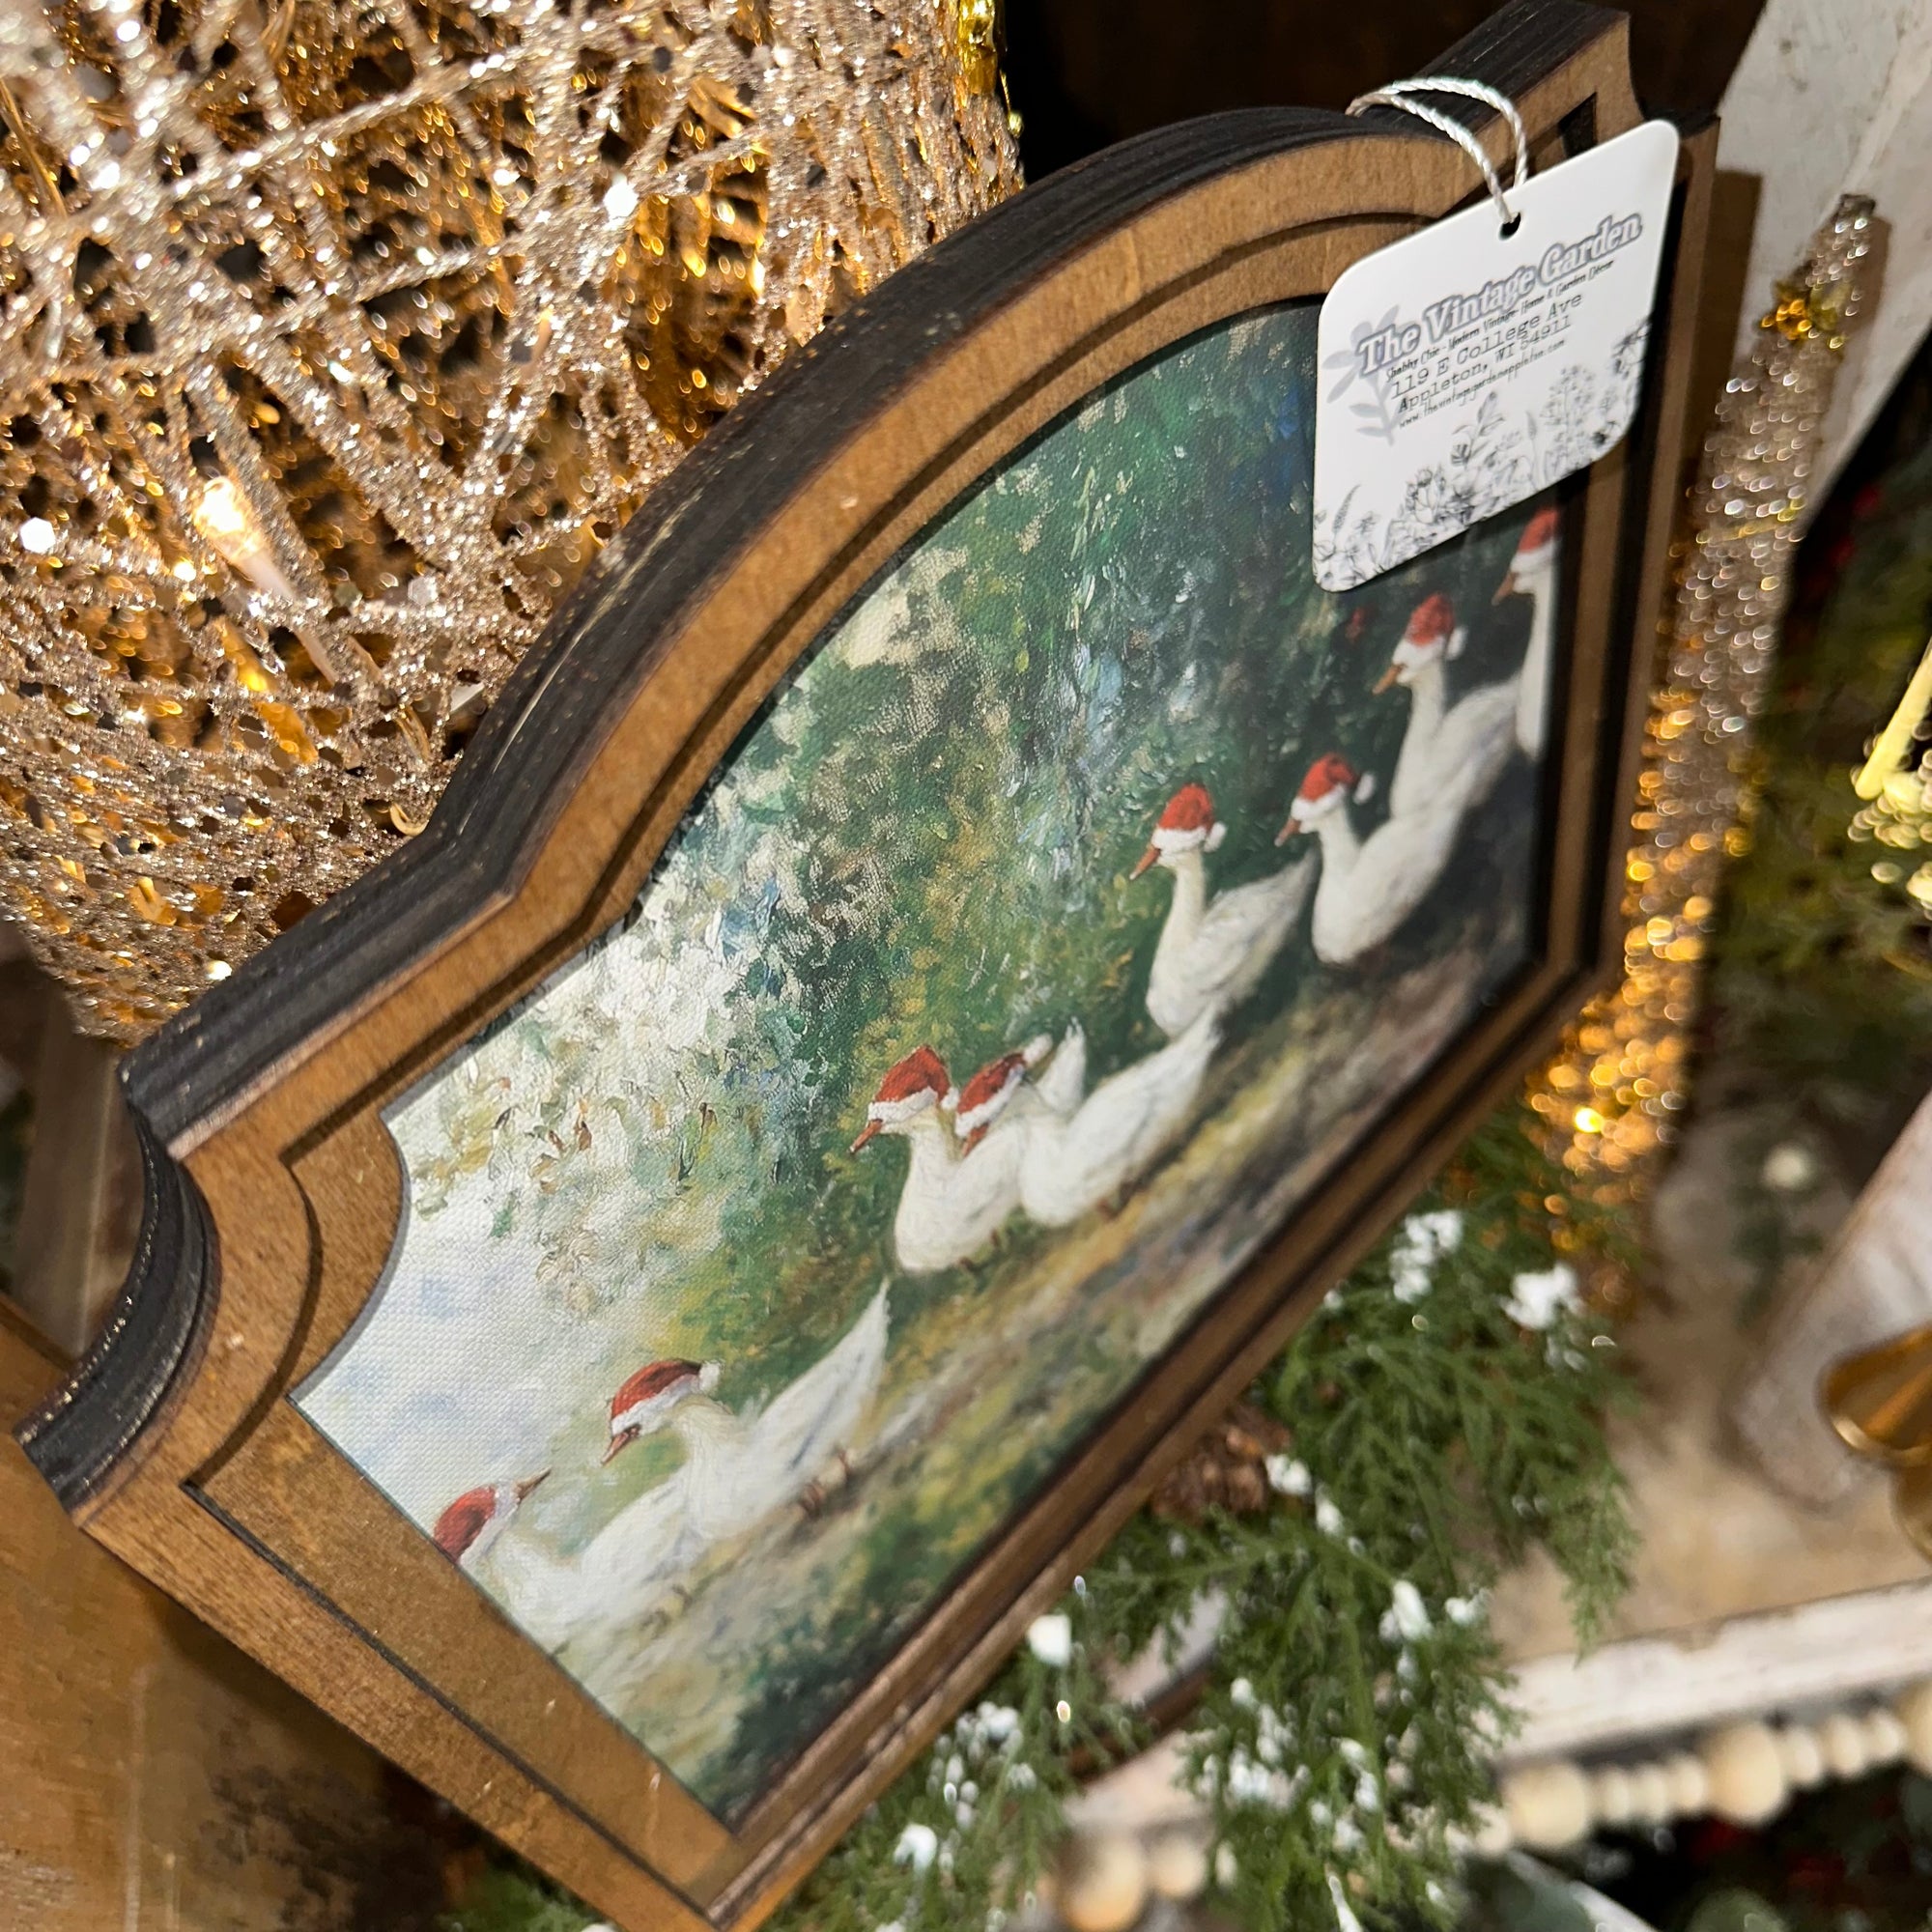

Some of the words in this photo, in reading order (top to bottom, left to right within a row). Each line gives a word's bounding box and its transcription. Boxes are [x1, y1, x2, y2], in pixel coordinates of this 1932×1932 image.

[1354, 324, 1421, 378] The
[1422, 266, 1538, 344] Vintage
[1536, 213, 1643, 288] Garden
[1386, 358, 1419, 383] Shabby
[1520, 296, 1545, 316] Home
[1555, 274, 1586, 297] Garden
[1390, 368, 1429, 400] 119
[1436, 357, 1450, 377] E
[1456, 316, 1541, 365] College
[1548, 294, 1582, 321] Ave
[1398, 364, 1489, 413] Appleton,
[1495, 342, 1515, 362] WI
[1520, 315, 1571, 351] 54911
